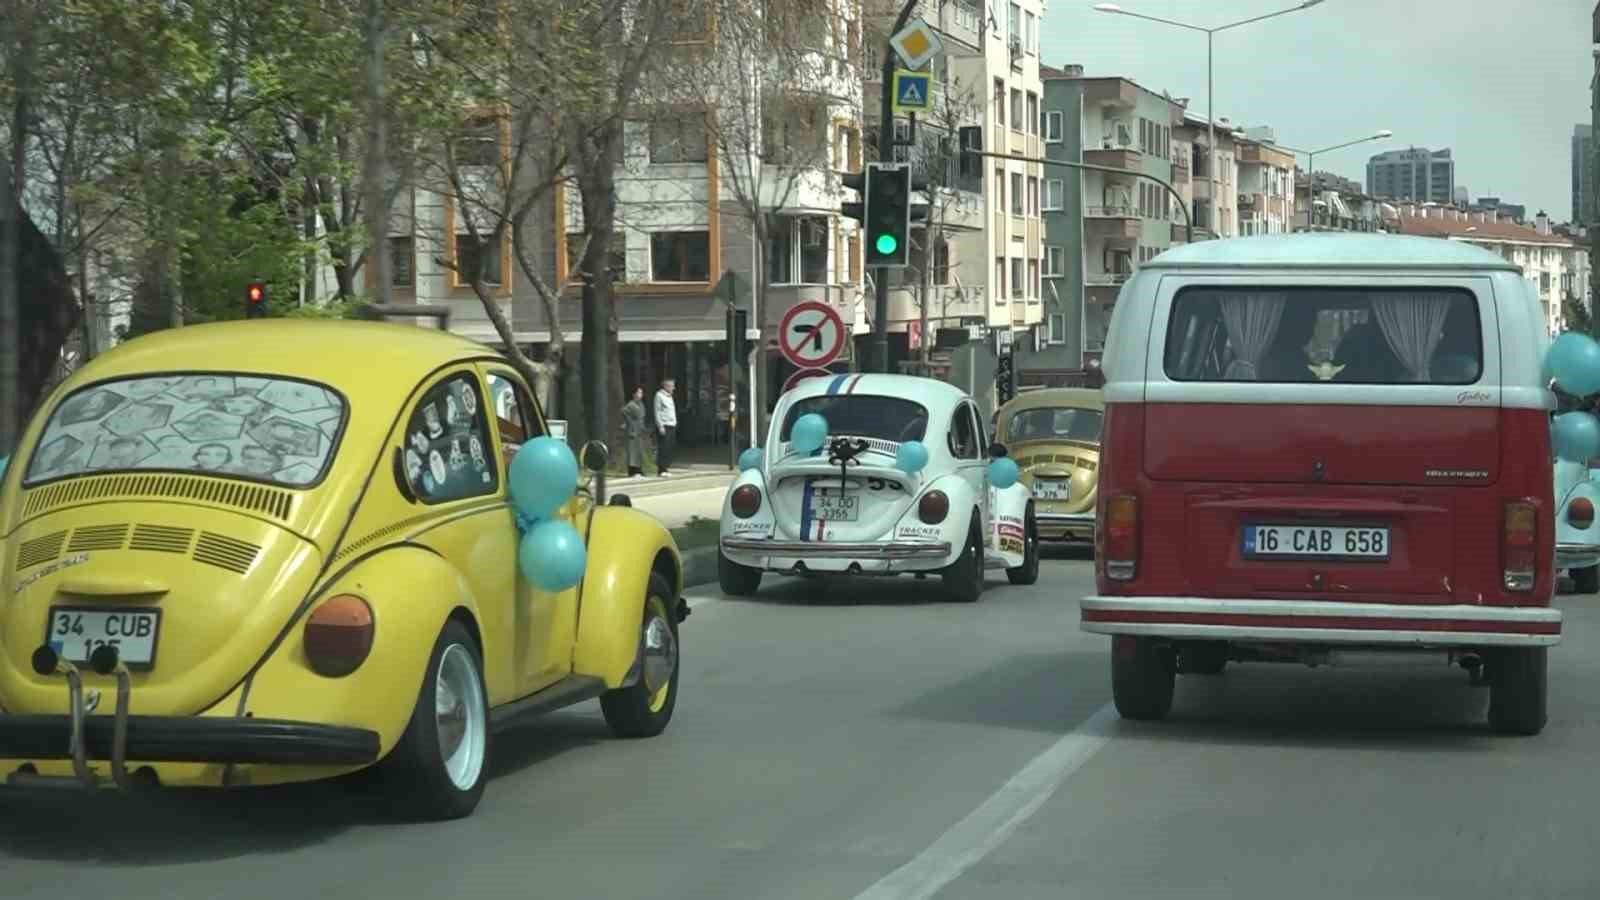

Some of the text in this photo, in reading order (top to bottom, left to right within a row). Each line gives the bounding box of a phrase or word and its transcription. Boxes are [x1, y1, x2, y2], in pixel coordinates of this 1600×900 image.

[734, 523, 771, 532] TRACKER
[898, 526, 941, 538] TRACKER
[1258, 528, 1278, 551] 16
[1293, 529, 1333, 552] CAB
[1345, 530, 1384, 553] 658
[57, 614, 152, 637] 34 CUB
